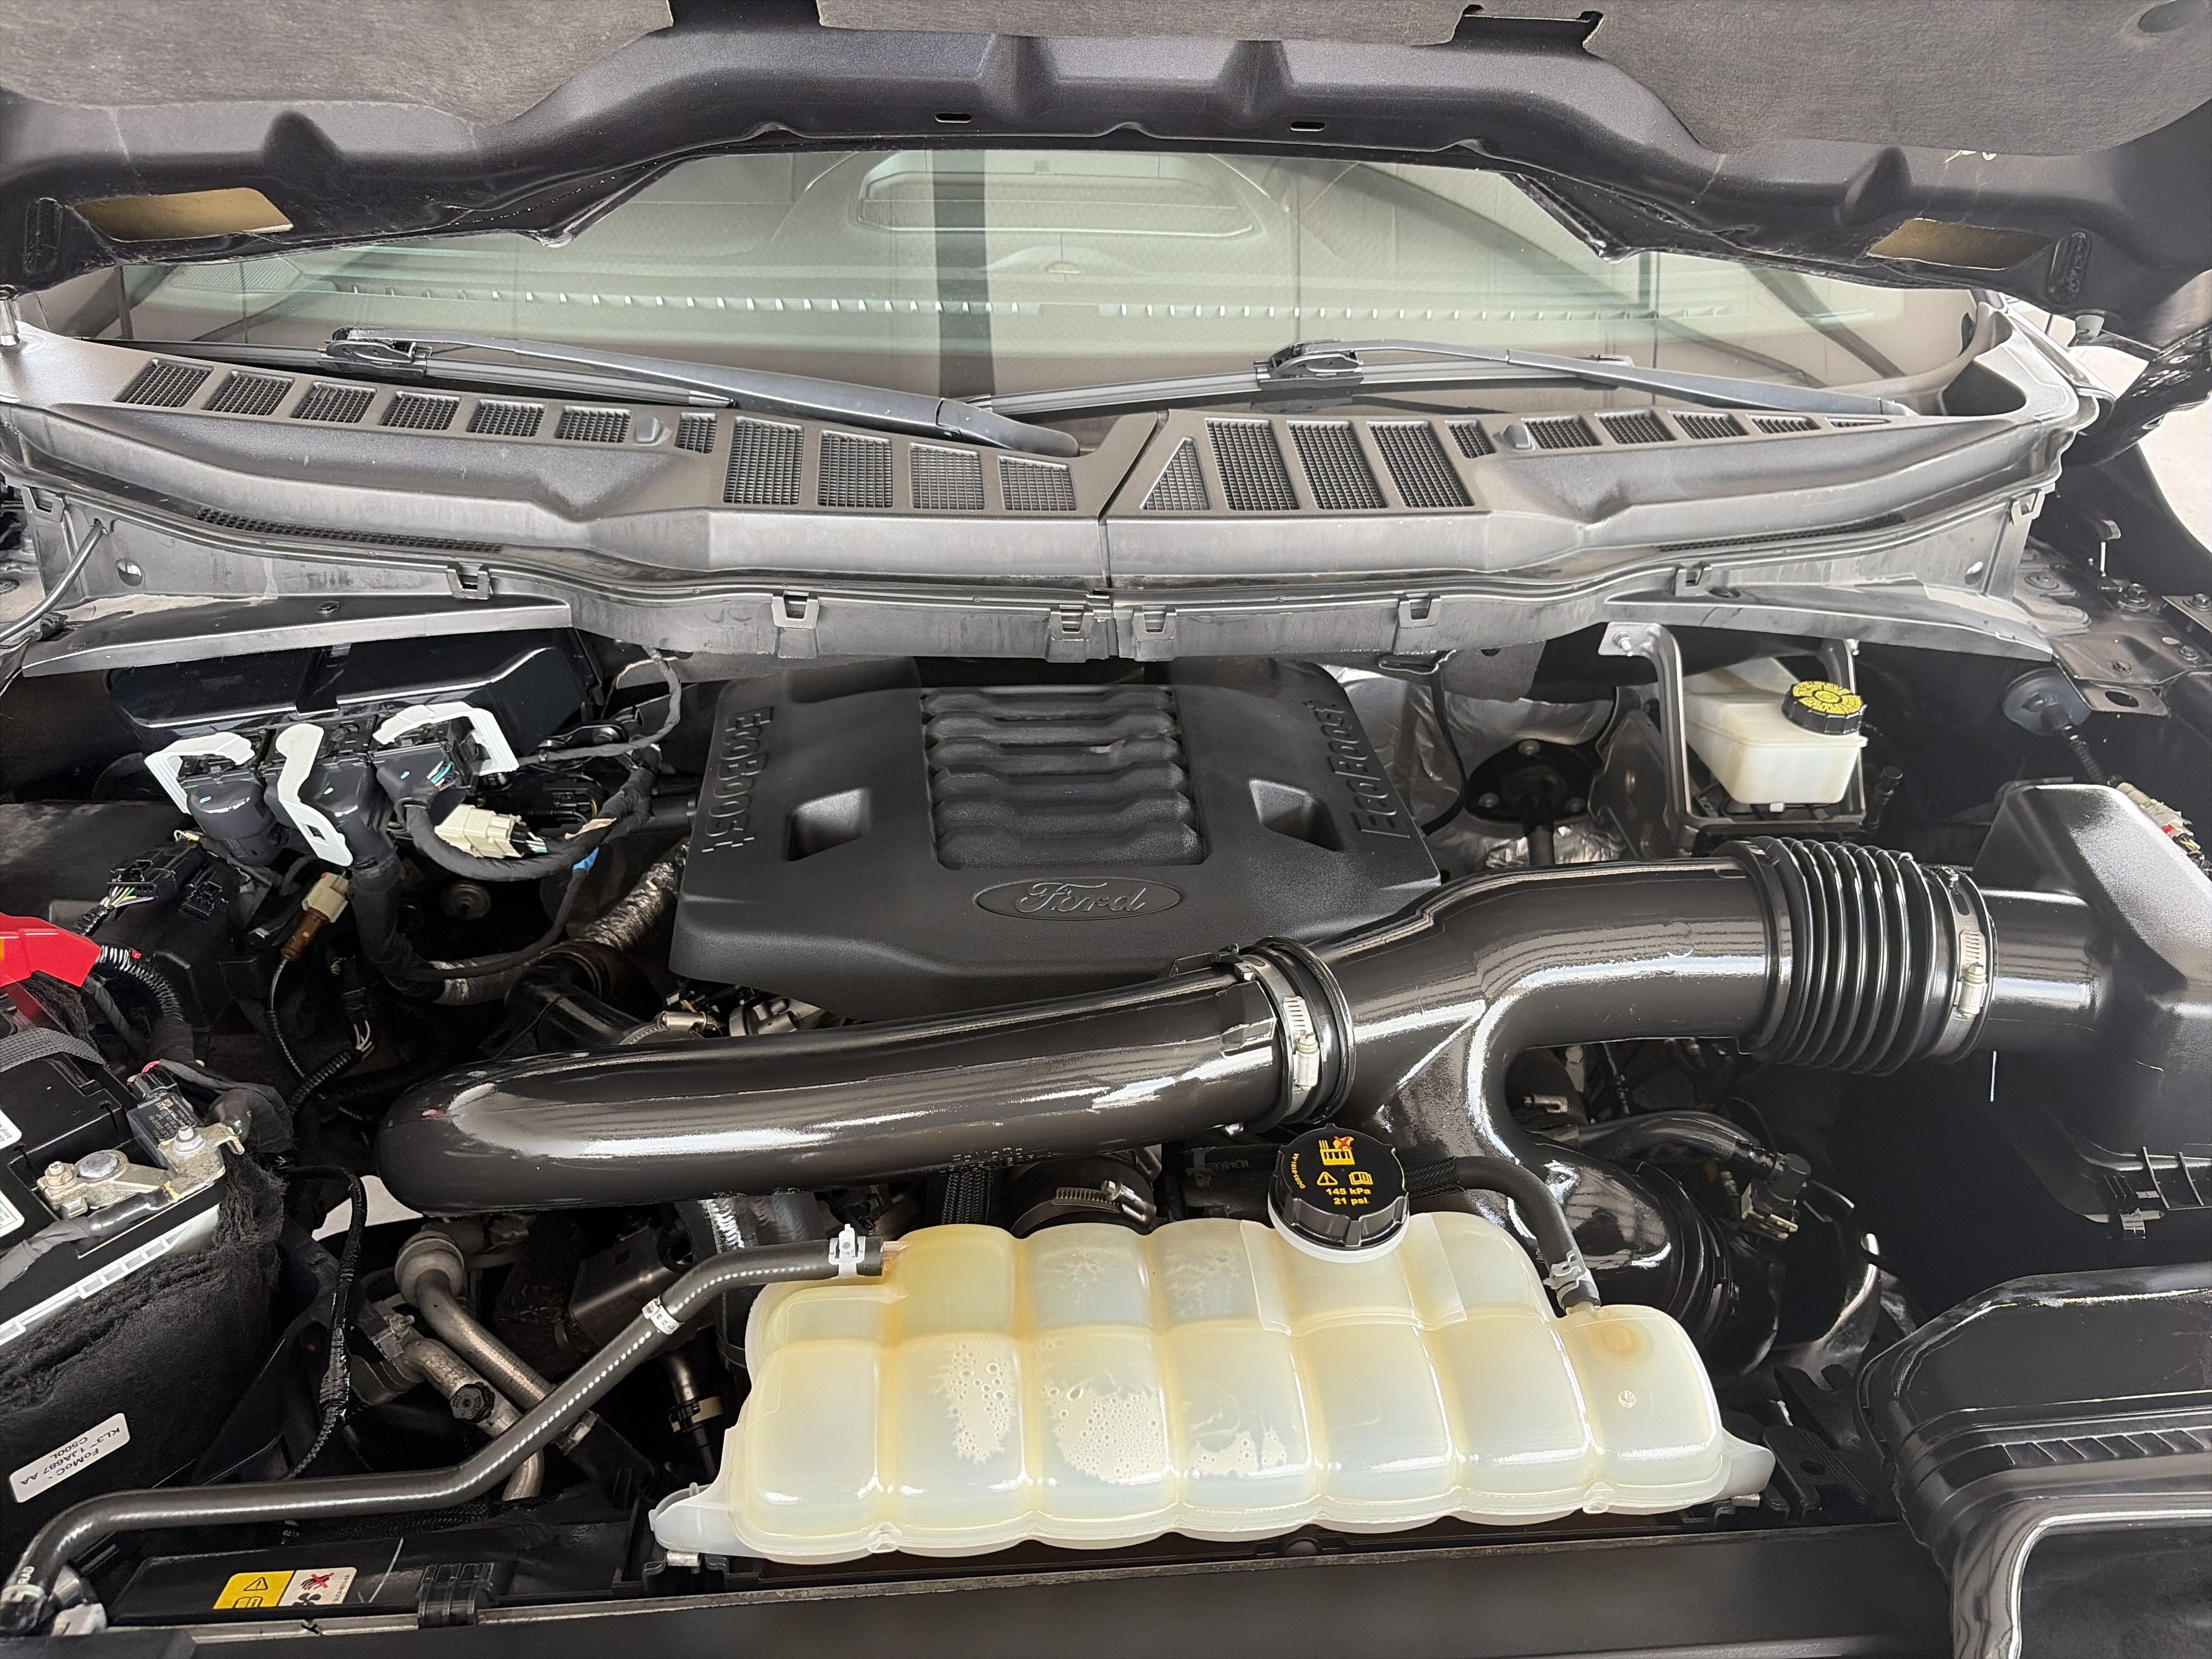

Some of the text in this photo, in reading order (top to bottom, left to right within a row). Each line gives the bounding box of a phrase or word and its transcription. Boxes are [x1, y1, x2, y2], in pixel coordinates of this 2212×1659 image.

[1015, 882, 1146, 913] Ford
[1333, 1197, 1347, 1205] 21
[49, 1437, 87, 1459] C500L
